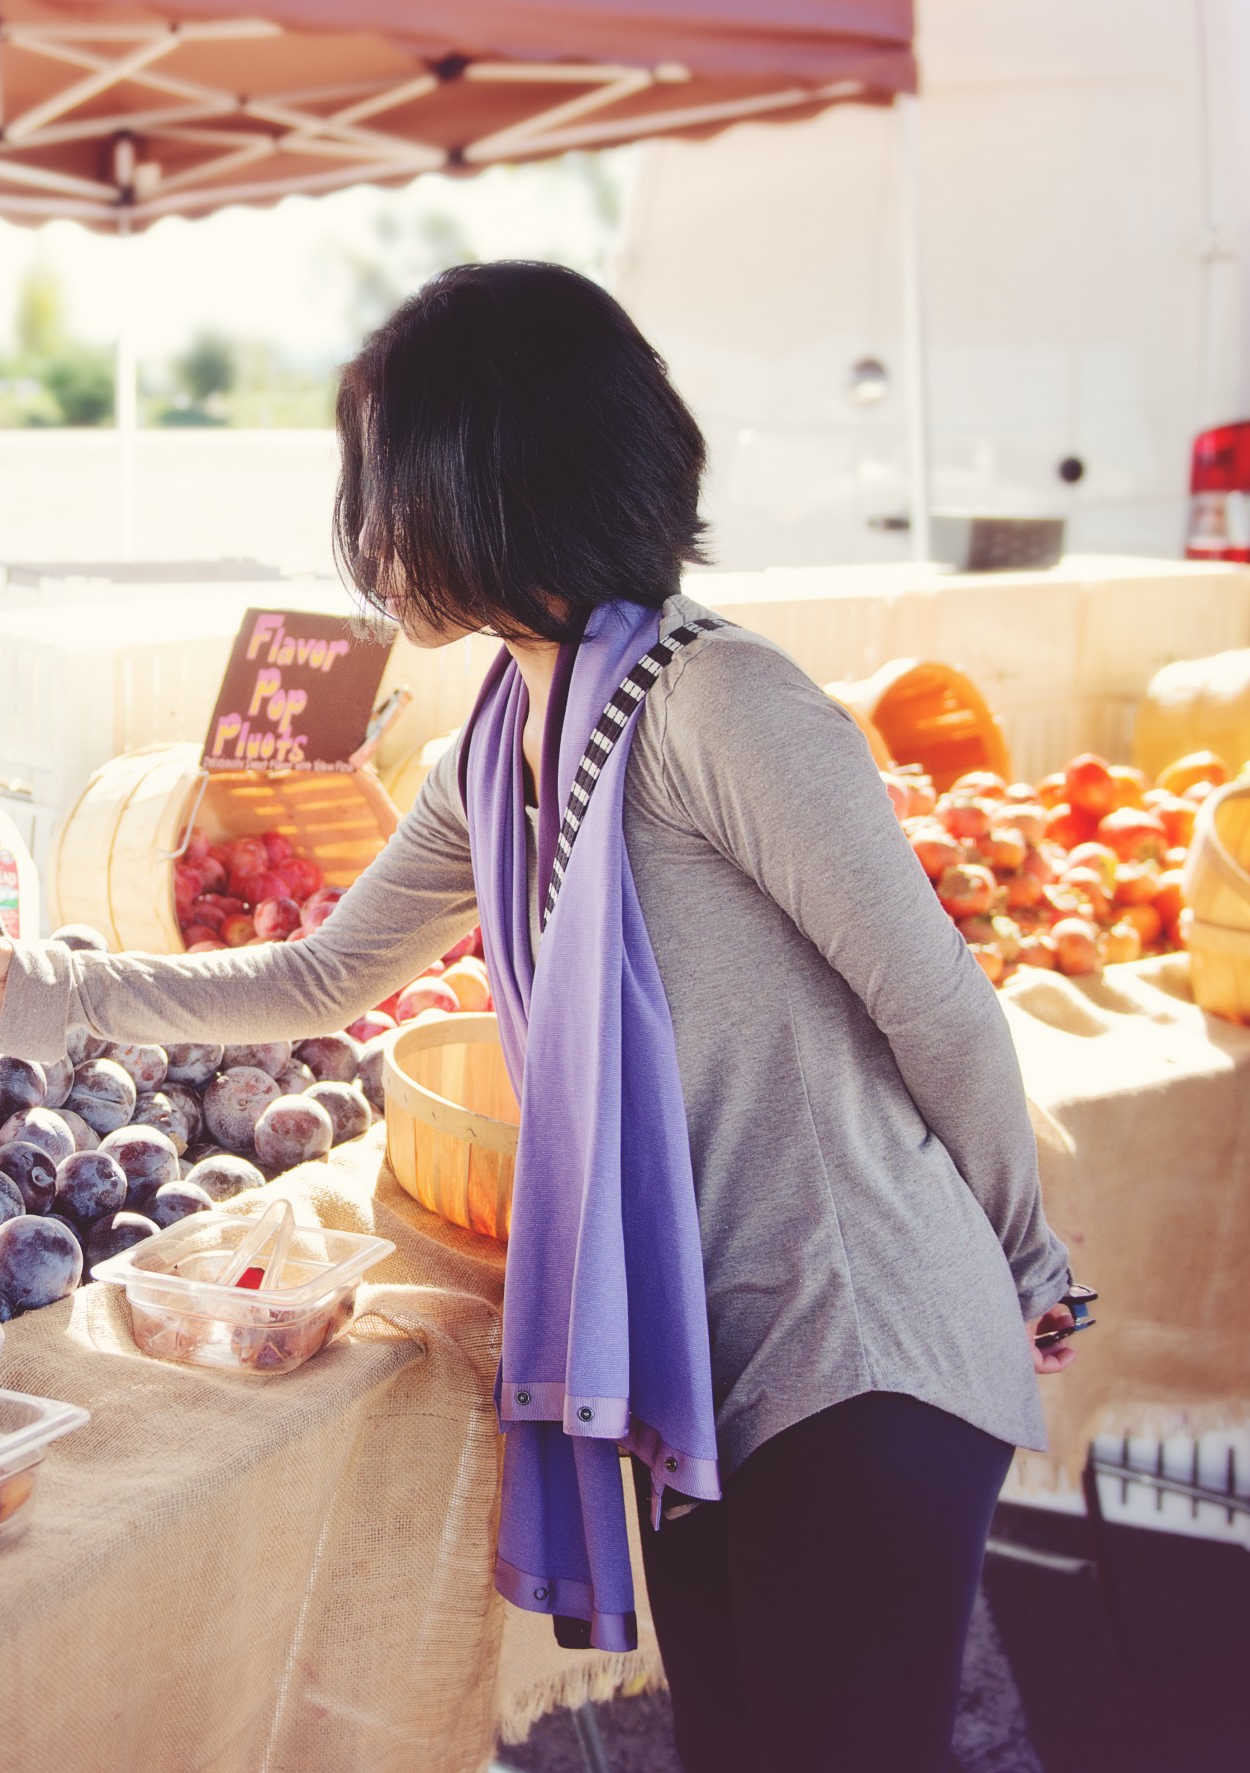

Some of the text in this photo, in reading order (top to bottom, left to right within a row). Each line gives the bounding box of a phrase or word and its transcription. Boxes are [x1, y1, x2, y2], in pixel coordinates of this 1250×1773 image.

[246, 613, 350, 673] Flavor
[248, 667, 308, 734] Pop
[212, 712, 308, 763] Pluots
